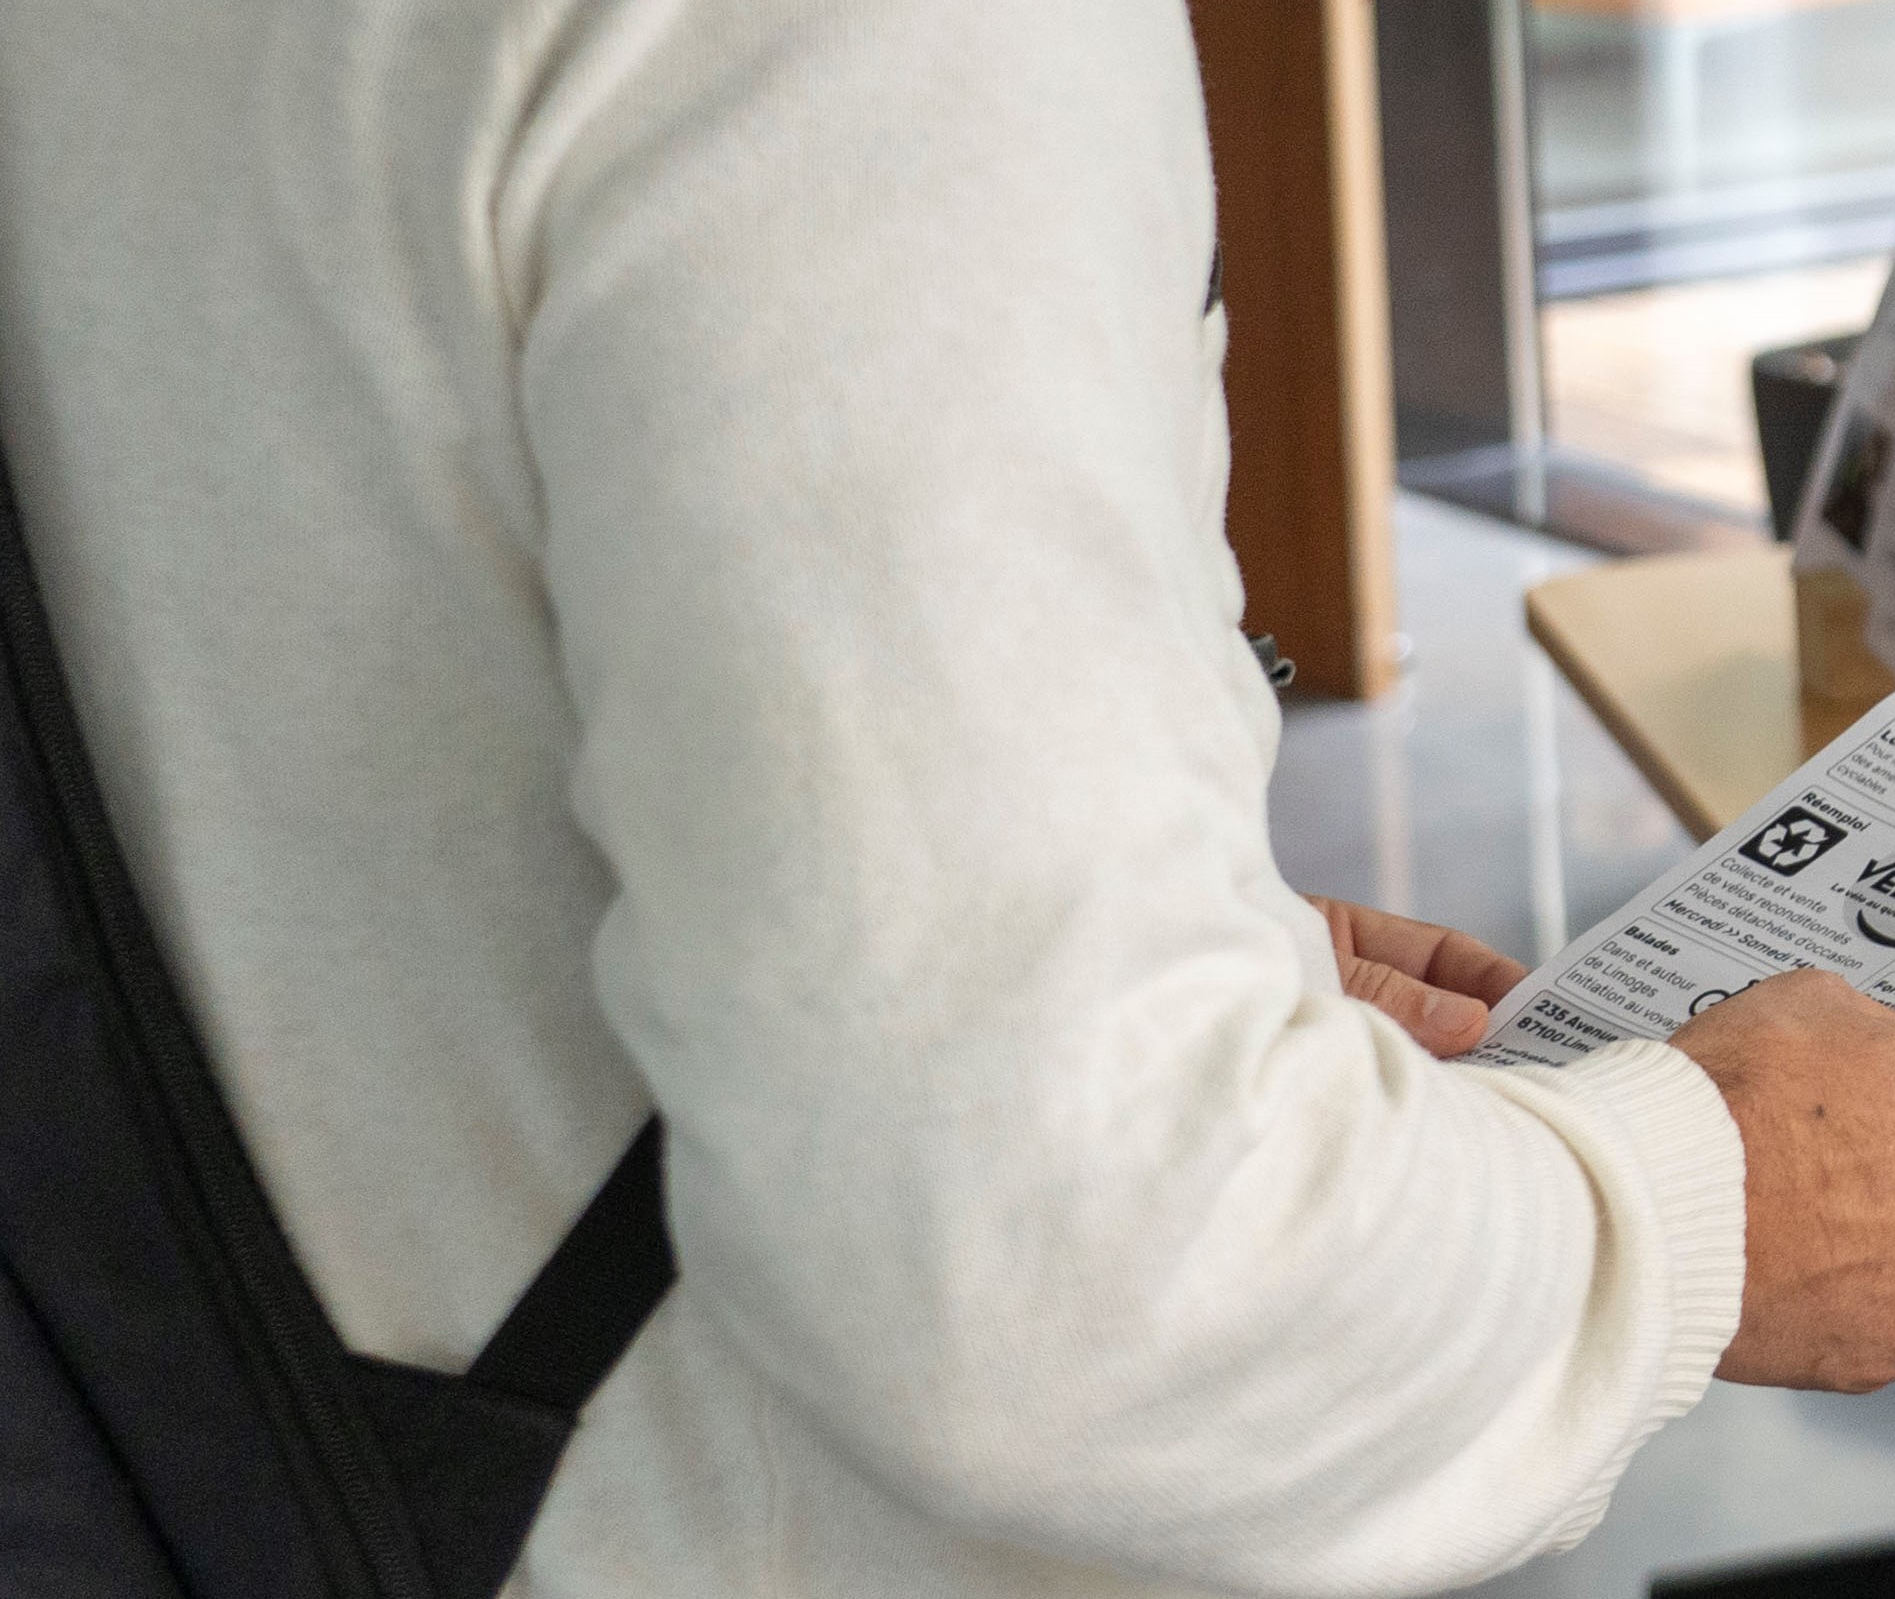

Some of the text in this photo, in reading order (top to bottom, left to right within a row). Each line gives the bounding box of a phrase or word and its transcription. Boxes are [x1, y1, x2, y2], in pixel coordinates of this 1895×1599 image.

[1851, 753, 1873, 769] des
[1866, 742, 1892, 761] Pour
[1837, 764, 1888, 796] cyclables
[1801, 791, 1872, 833] Réemploi
[1721, 857, 1828, 915] Collecte et vente
[1830, 882, 1845, 893] Le
[1845, 889, 1867, 903] vélo
[1865, 900, 1881, 910] au
[1685, 882, 1864, 970] Pièces détachées d'occasion
[1702, 871, 1853, 946] de vélos reconditionnés
[1624, 925, 1680, 956] Balades
[1664, 899, 1727, 932] Mercredi
[1738, 934, 1795, 964] Samedi
[1583, 955, 1659, 998] de Limoges
[1602, 940, 1697, 991] Dans et autour
[1534, 999, 1619, 1043] 235 Avenue
[1566, 969, 1682, 1032] Initiation au voyag
[1516, 1016, 1566, 1043] 87100
